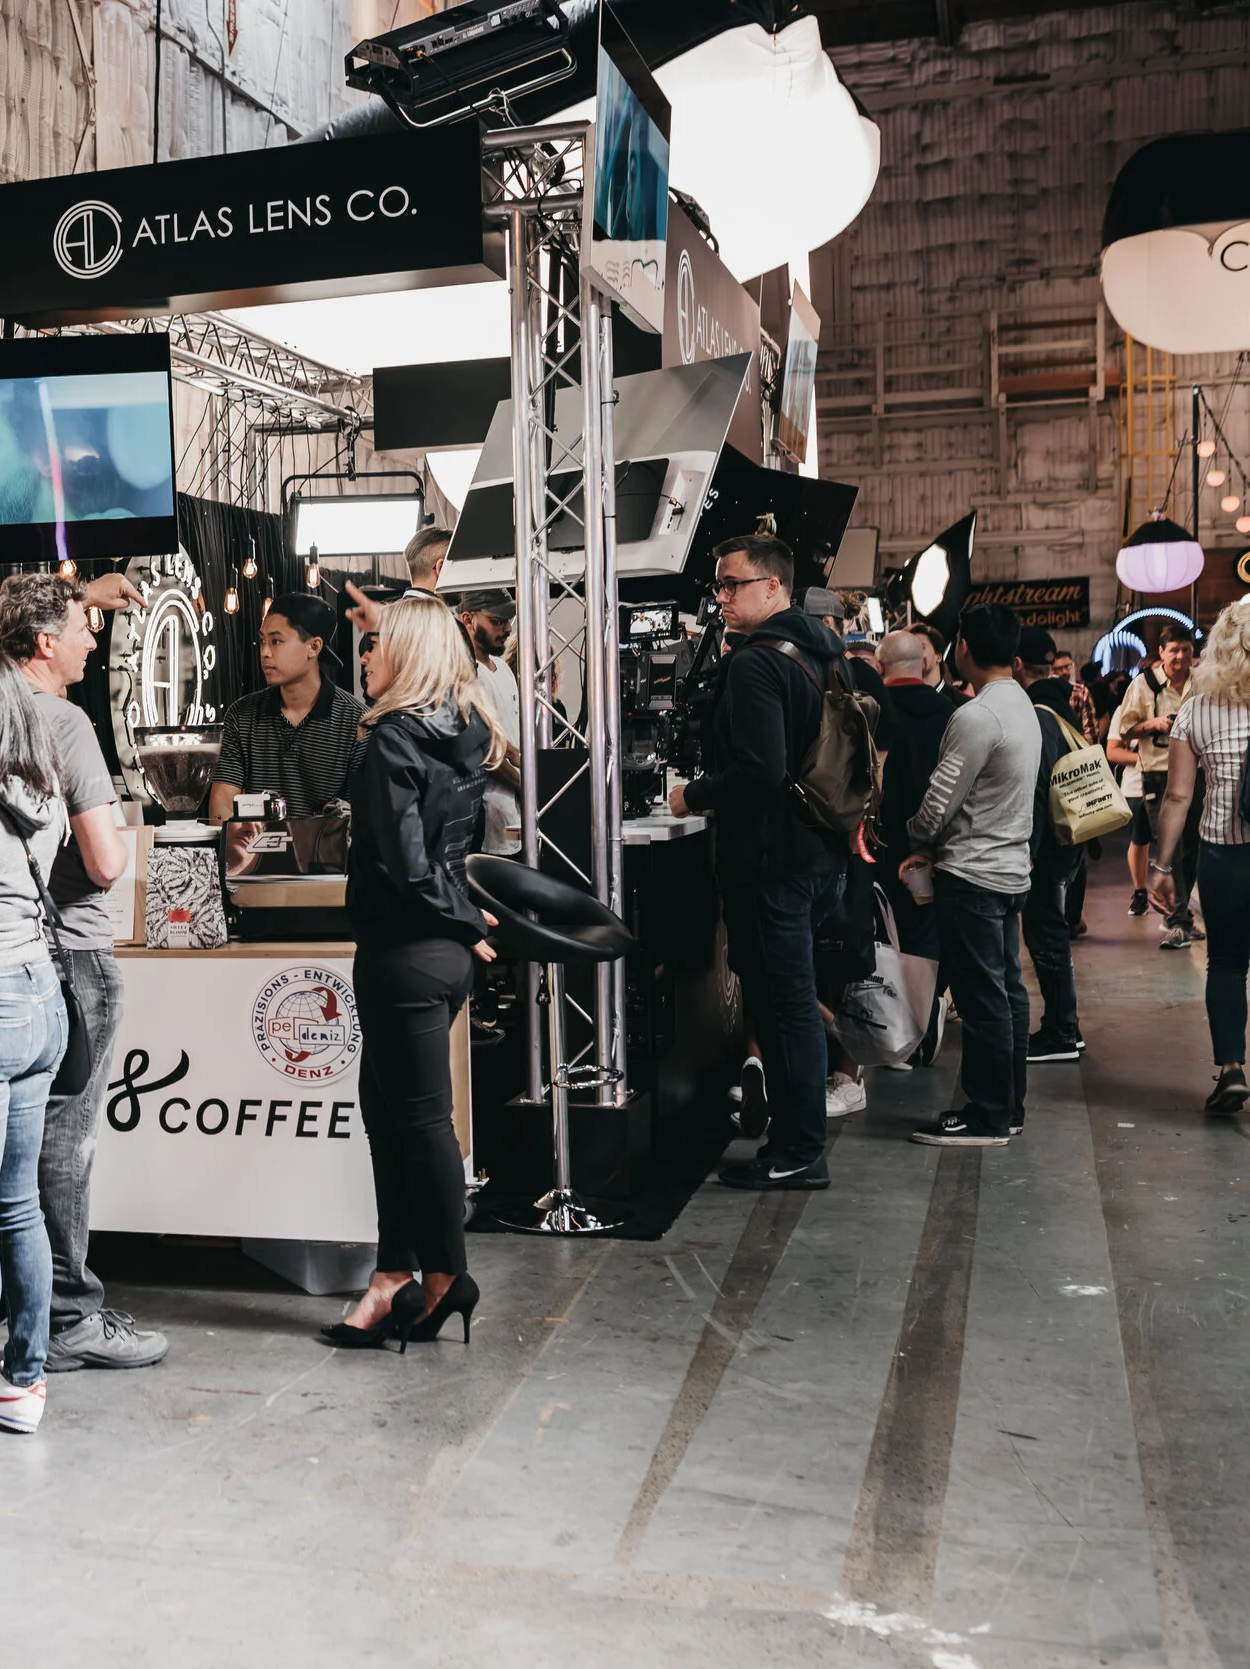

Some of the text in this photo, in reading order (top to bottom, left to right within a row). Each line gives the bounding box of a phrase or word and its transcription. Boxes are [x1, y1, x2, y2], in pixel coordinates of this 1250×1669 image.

[132, 186, 418, 248] ATLAS LENS CO.
[284, 1064, 334, 1079] DENZ
[159, 1097, 356, 1139] COFFEE
